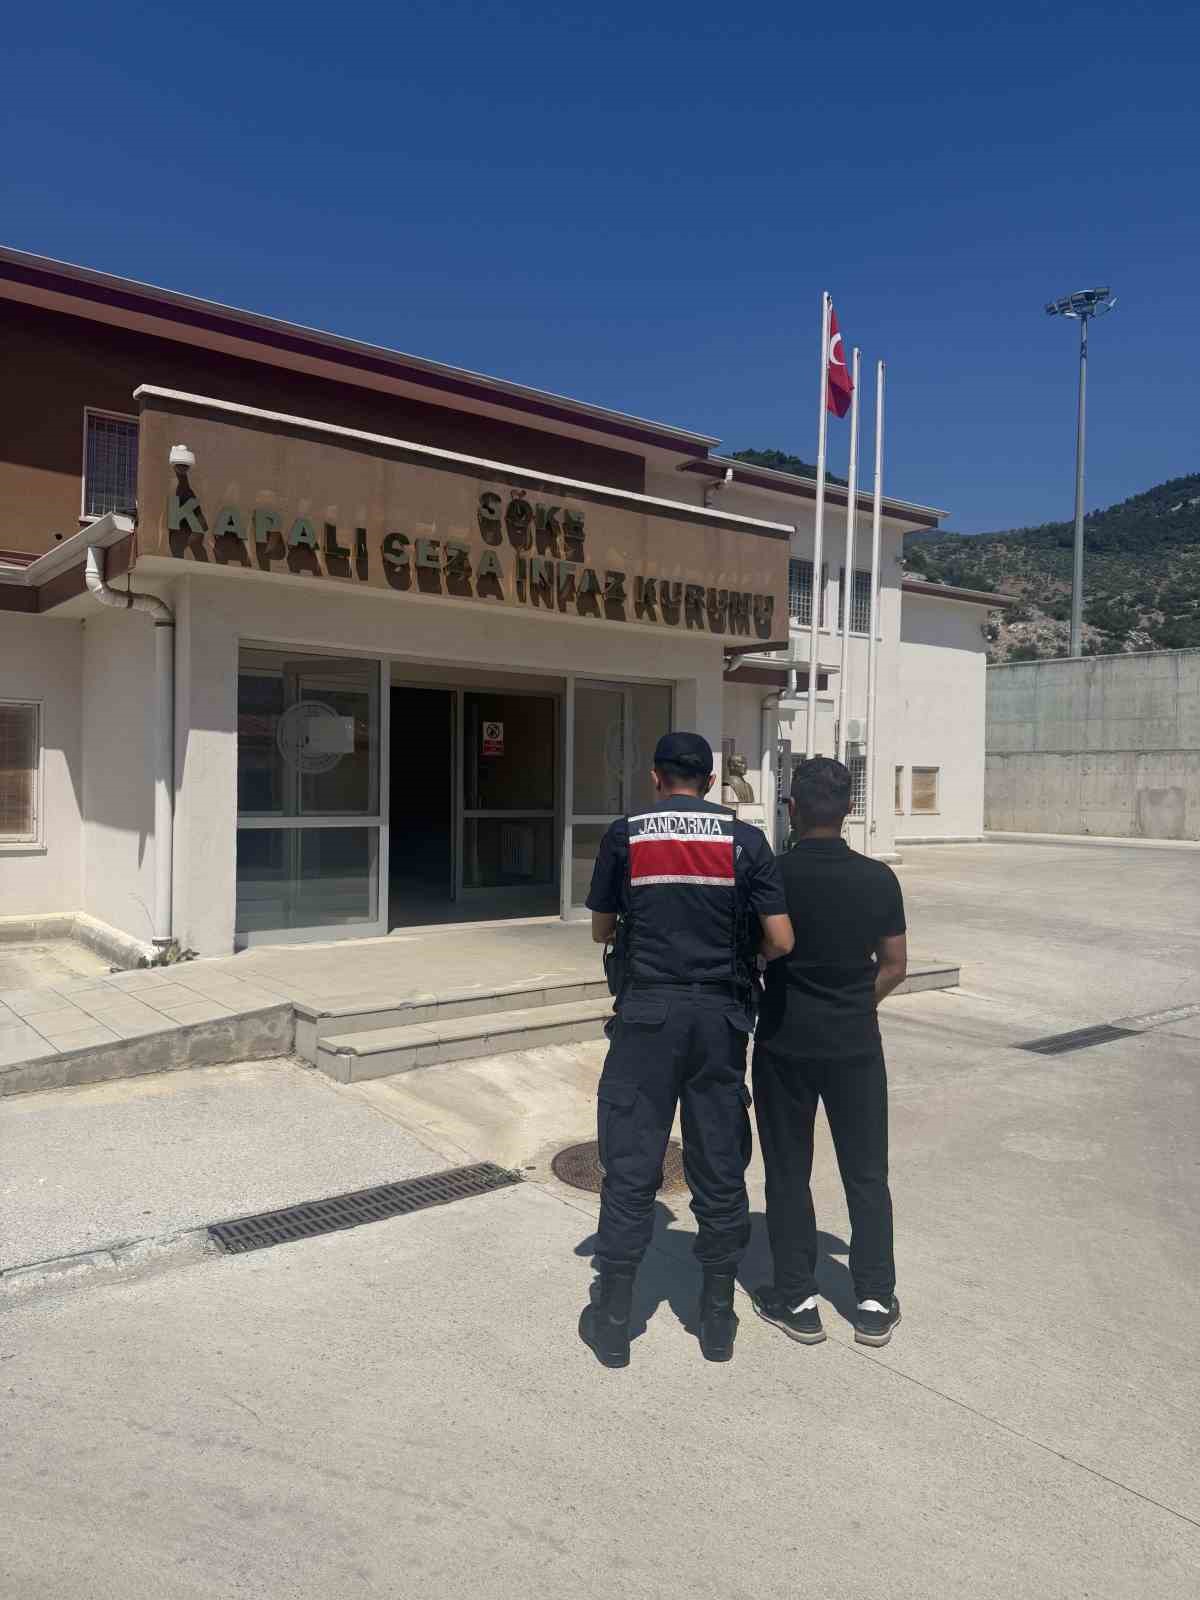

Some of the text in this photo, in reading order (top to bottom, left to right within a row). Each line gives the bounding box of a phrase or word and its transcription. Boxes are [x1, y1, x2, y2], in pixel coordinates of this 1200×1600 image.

[168, 495, 368, 563] KAPALI
[634, 575, 774, 630] KURUMU
[638, 816, 723, 835] JANDARMA
